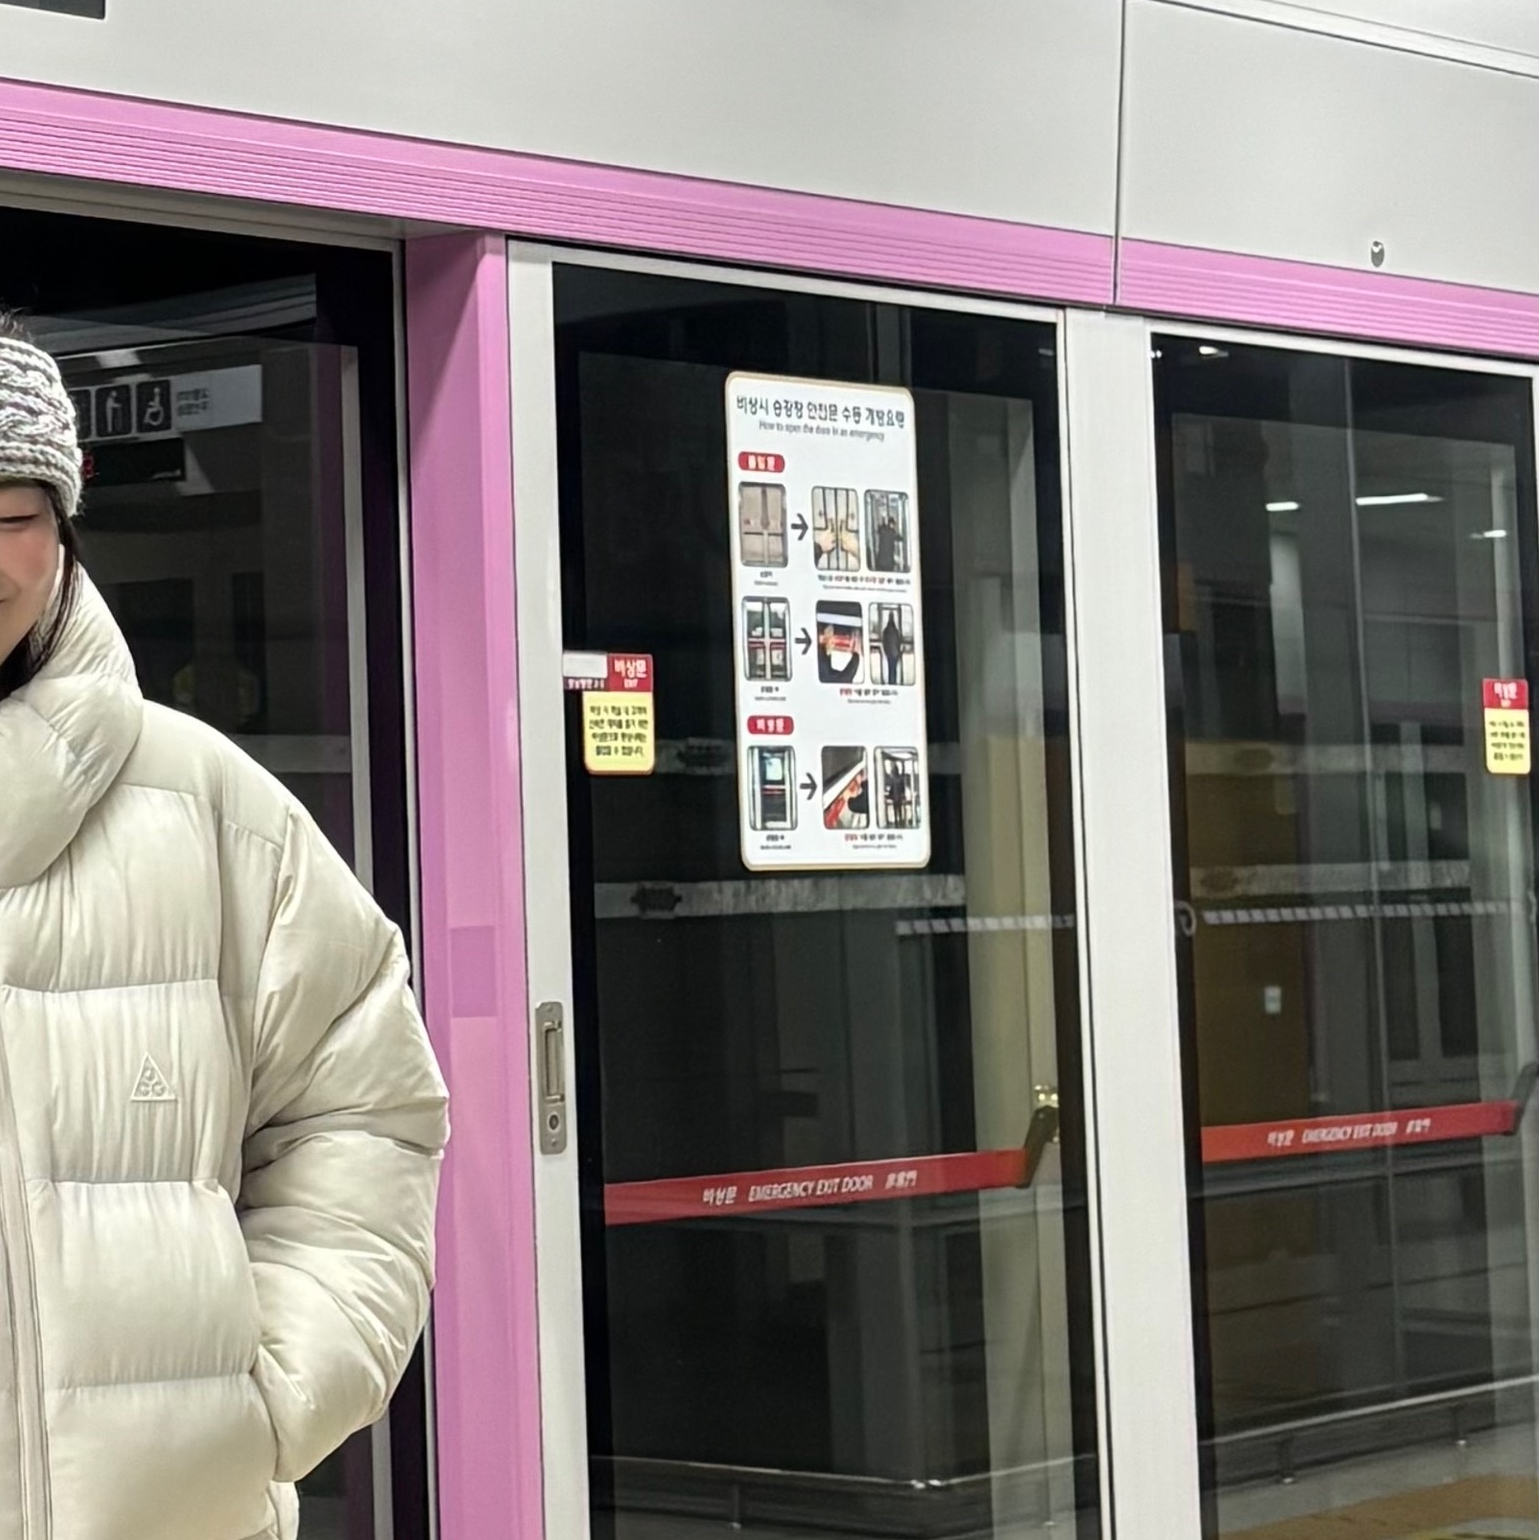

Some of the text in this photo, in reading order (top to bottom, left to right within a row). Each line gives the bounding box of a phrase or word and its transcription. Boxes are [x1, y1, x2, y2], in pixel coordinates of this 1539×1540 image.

[736, 395, 769, 416] 비상시
[748, 1175, 874, 1202] EMERGENCY EXIT DOOR
